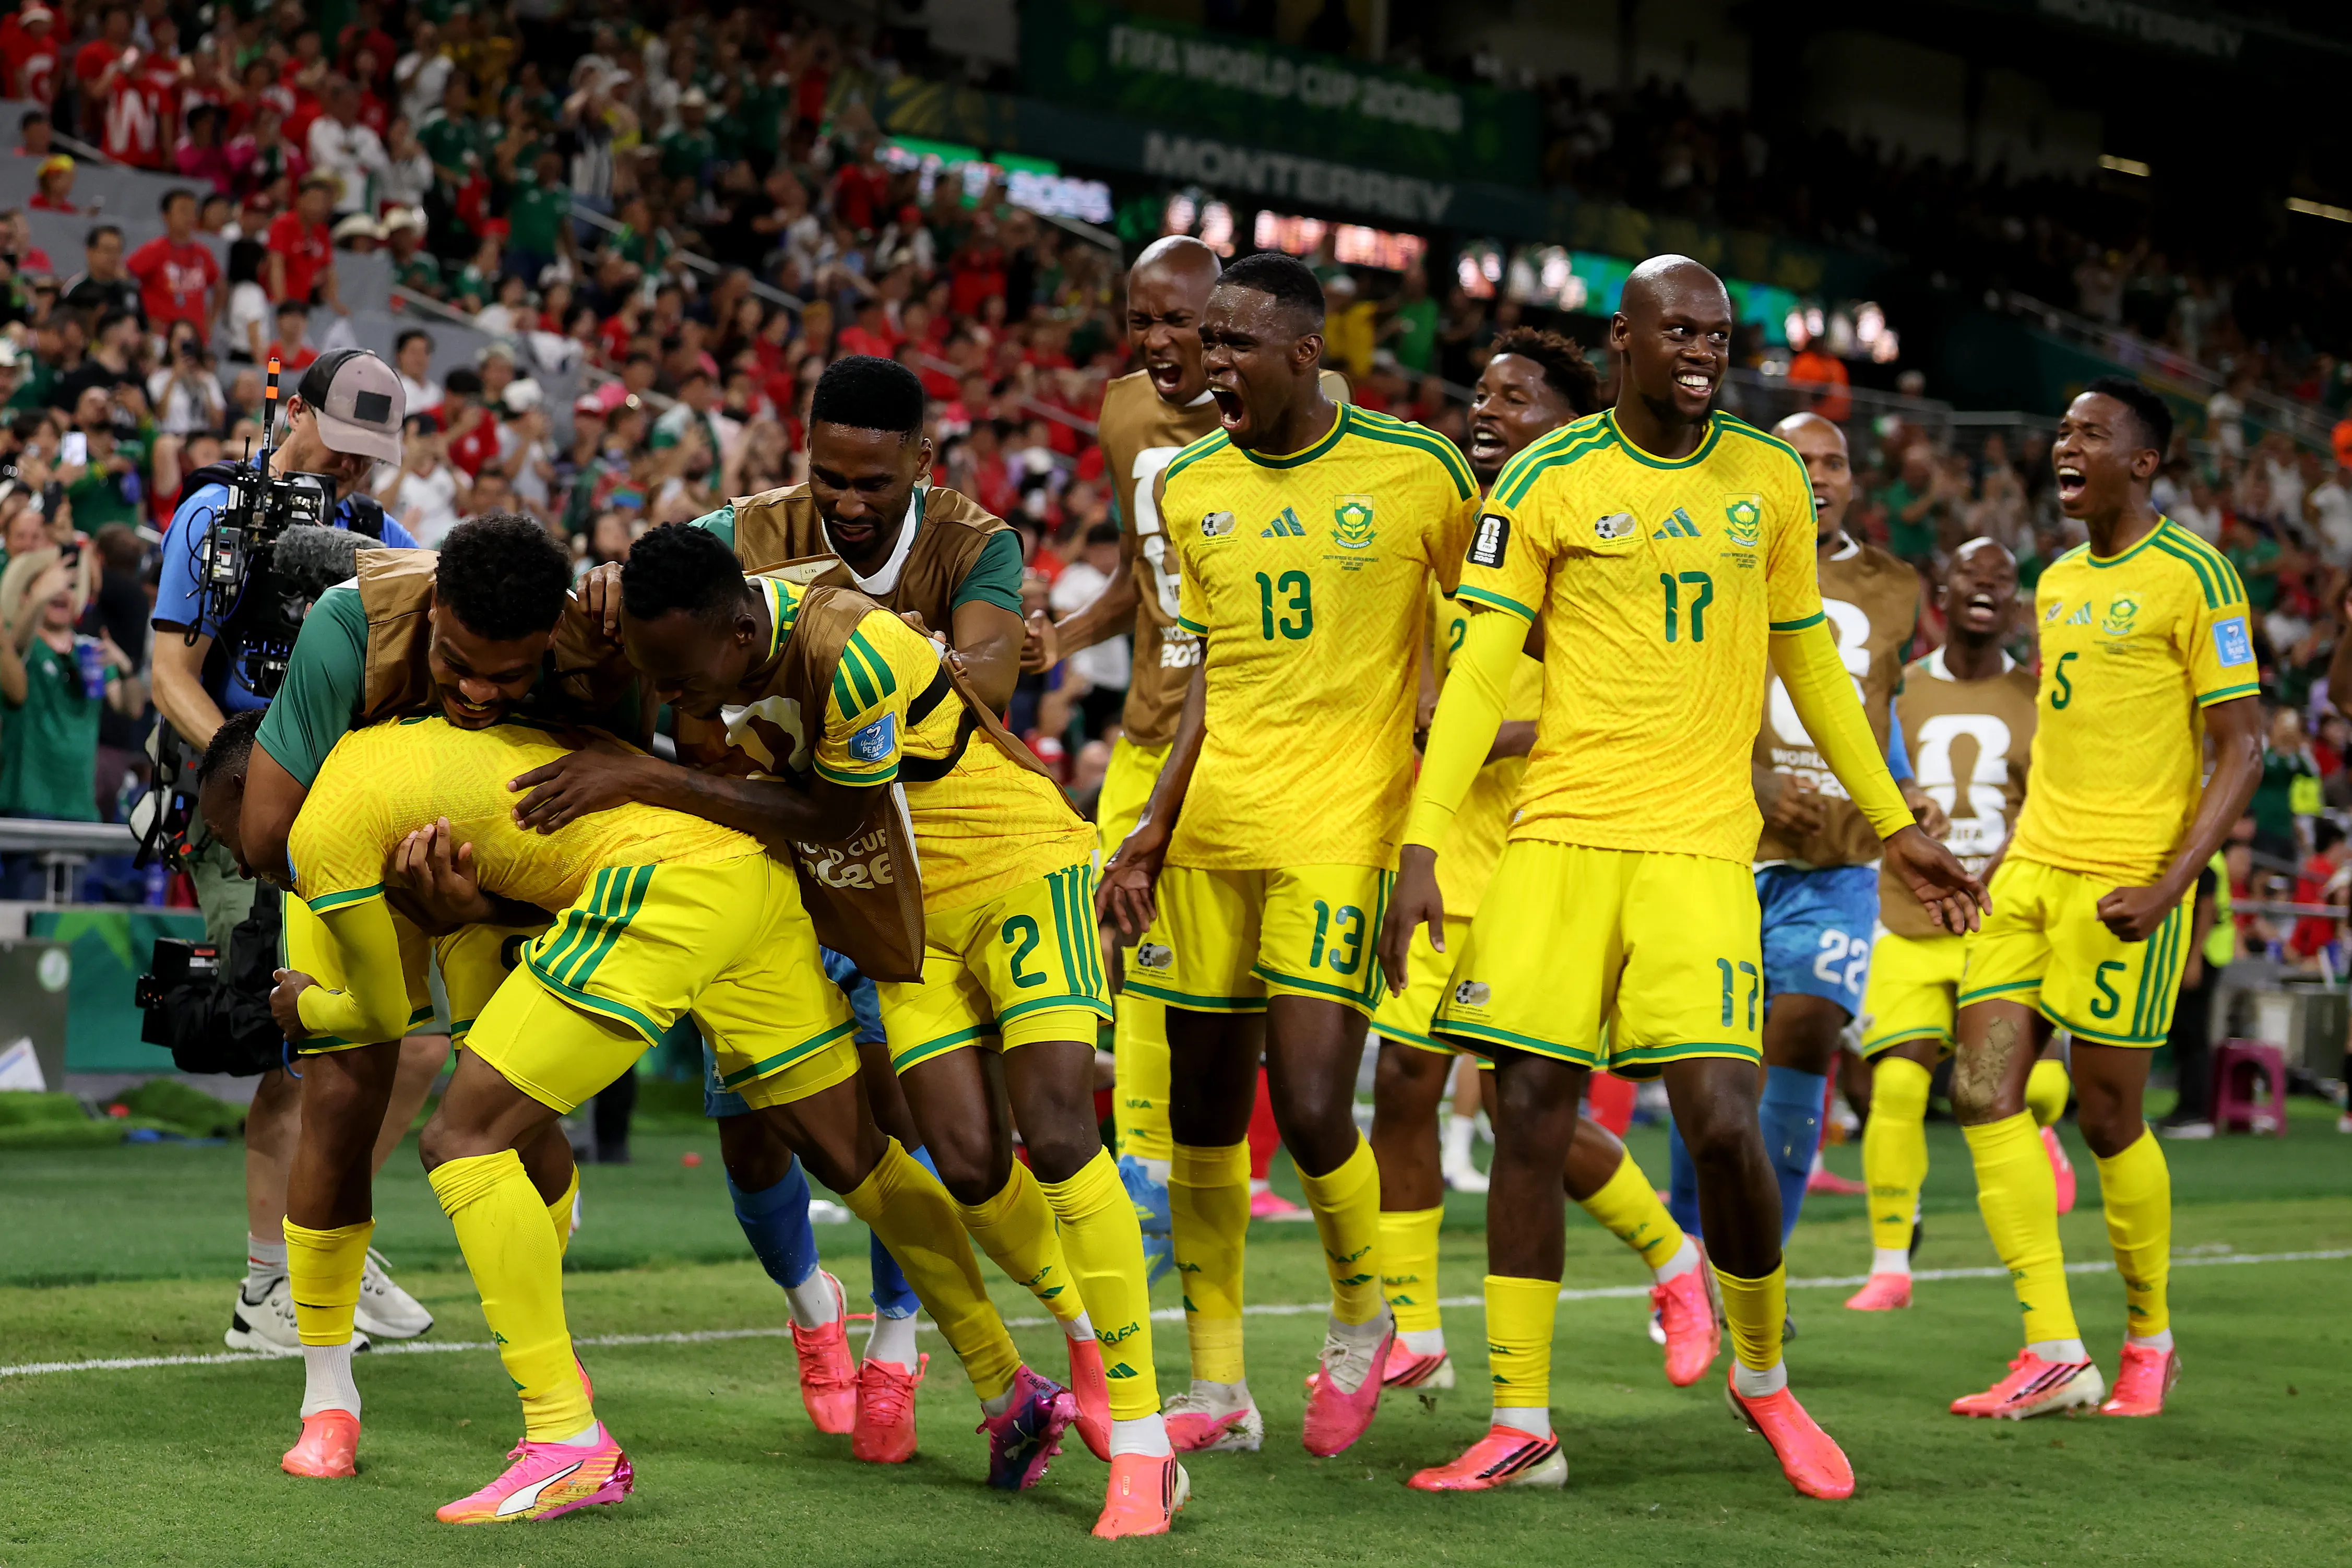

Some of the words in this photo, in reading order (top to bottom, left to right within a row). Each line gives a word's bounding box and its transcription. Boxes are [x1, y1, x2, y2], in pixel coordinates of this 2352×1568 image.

[1108, 25, 1178, 71] FIFA
[1186, 43, 1295, 98] WORLD
[1299, 64, 1357, 109] CUP
[1360, 76, 1463, 133] 2026
[1144, 130, 1453, 223] MONTERREY
[1337, 539, 1353, 548] SOUTH
[1255, 570, 1314, 640] 13
[1660, 571, 1714, 642] 17
[2051, 652, 2078, 709] 5
[862, 742, 884, 754] PEACE
[1001, 914, 1047, 988] 2
[1310, 899, 1366, 975] 13
[1813, 928, 1869, 995] 22
[1717, 958, 1759, 1032] 17
[2090, 961, 2127, 1019] 5
